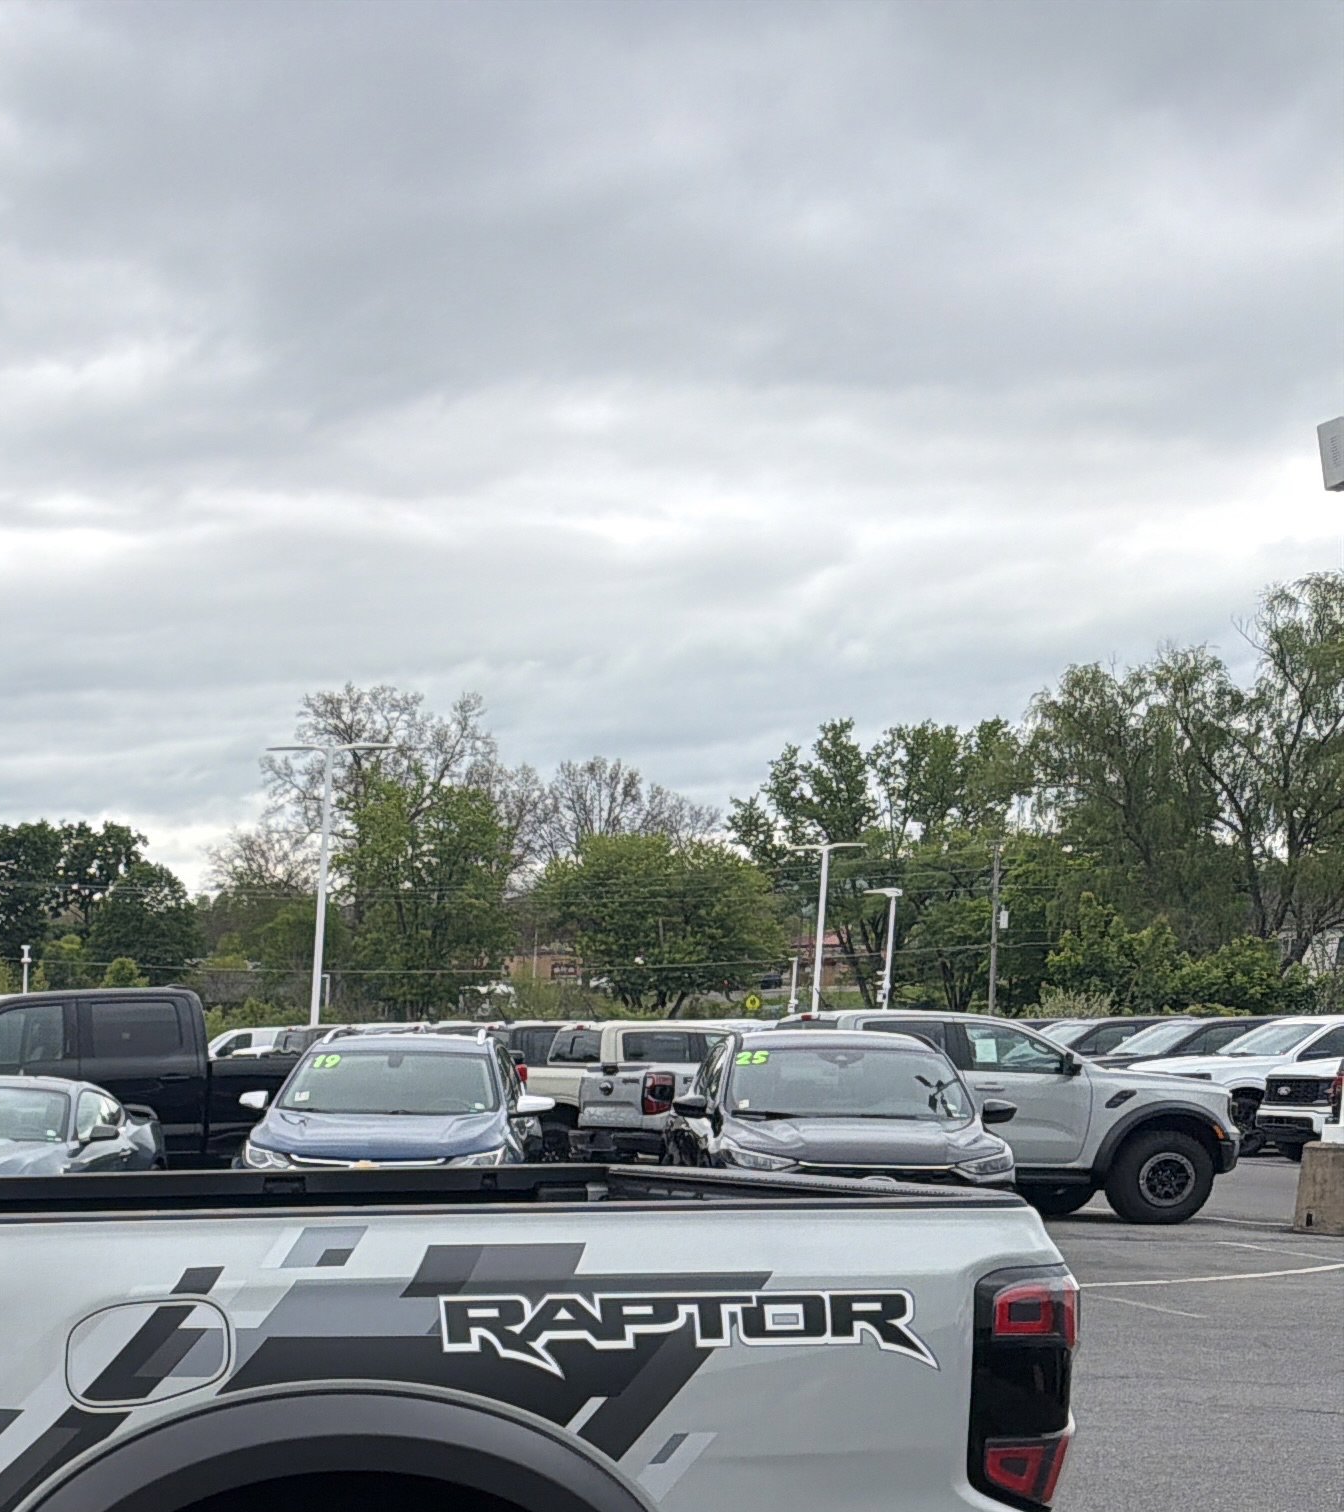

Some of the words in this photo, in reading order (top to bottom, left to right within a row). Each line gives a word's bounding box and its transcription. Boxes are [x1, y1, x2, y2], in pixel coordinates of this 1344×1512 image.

[313, 1054, 341, 1068] 19
[735, 1050, 769, 1065] 25
[438, 1289, 940, 1380] RAPTOR
